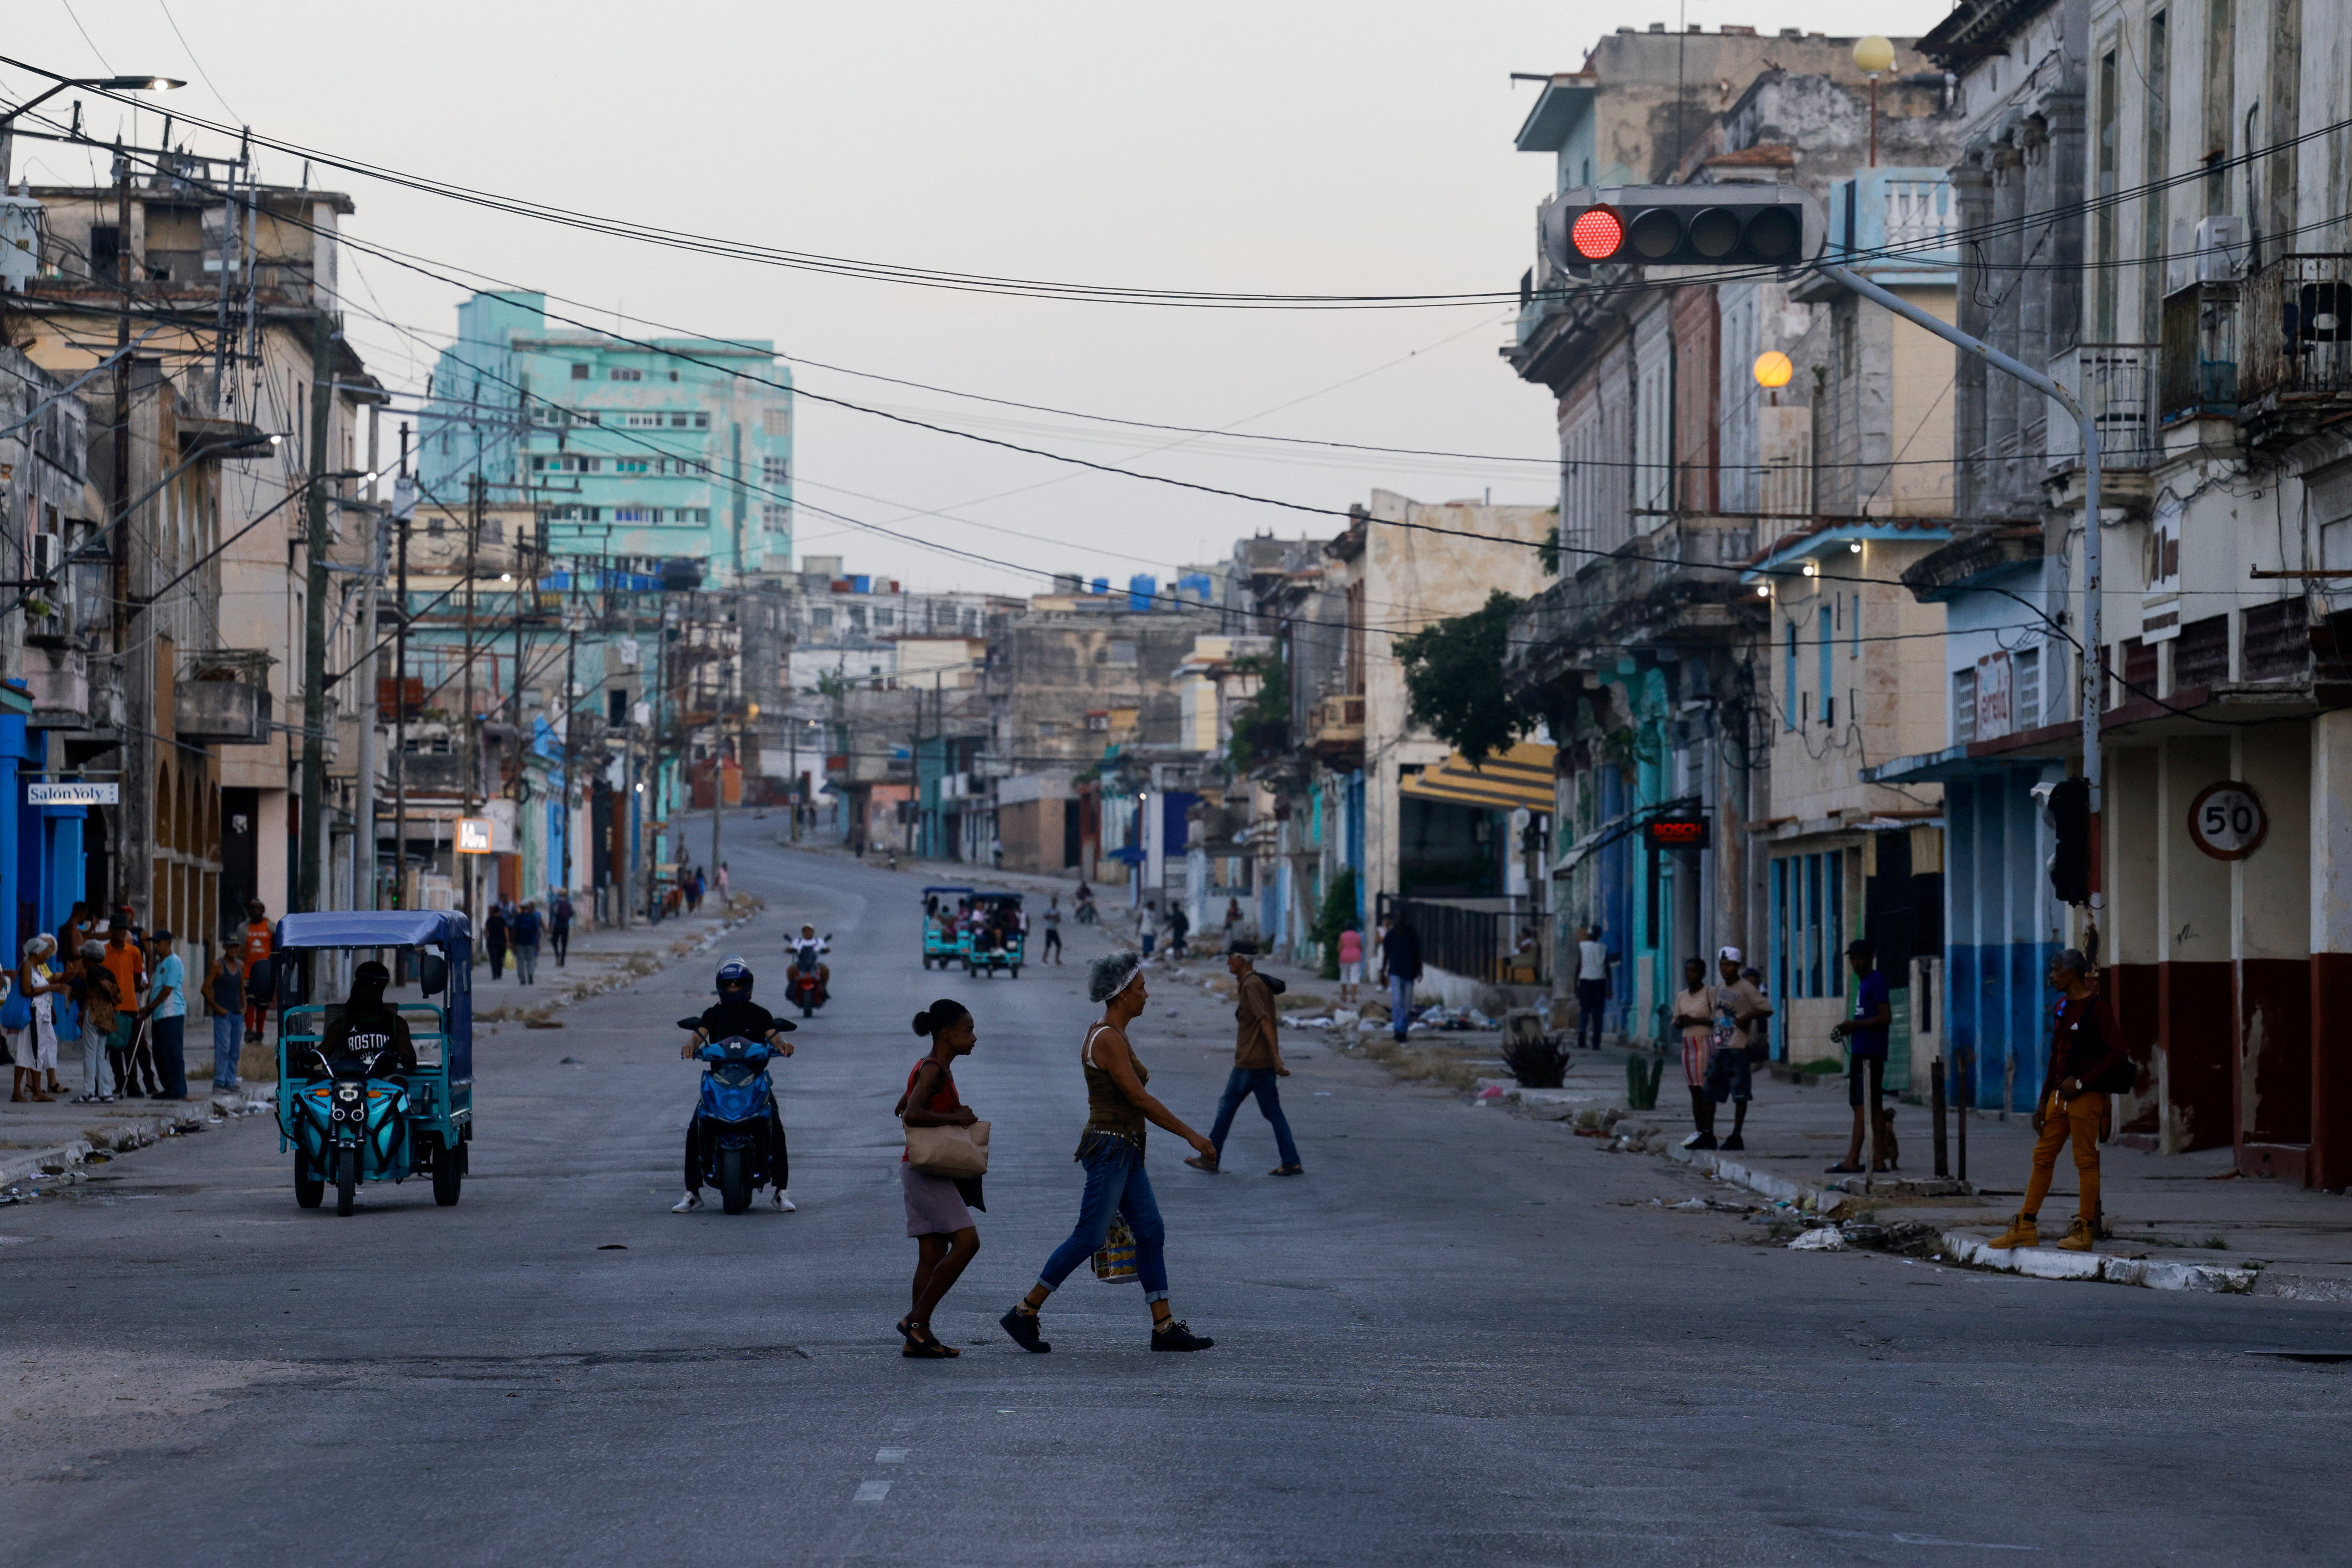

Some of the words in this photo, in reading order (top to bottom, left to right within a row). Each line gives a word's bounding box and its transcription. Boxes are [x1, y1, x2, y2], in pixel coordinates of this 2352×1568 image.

[30, 787, 71, 800] Salón
[73, 787, 104, 802] Yoly
[2206, 806, 2252, 834] 50
